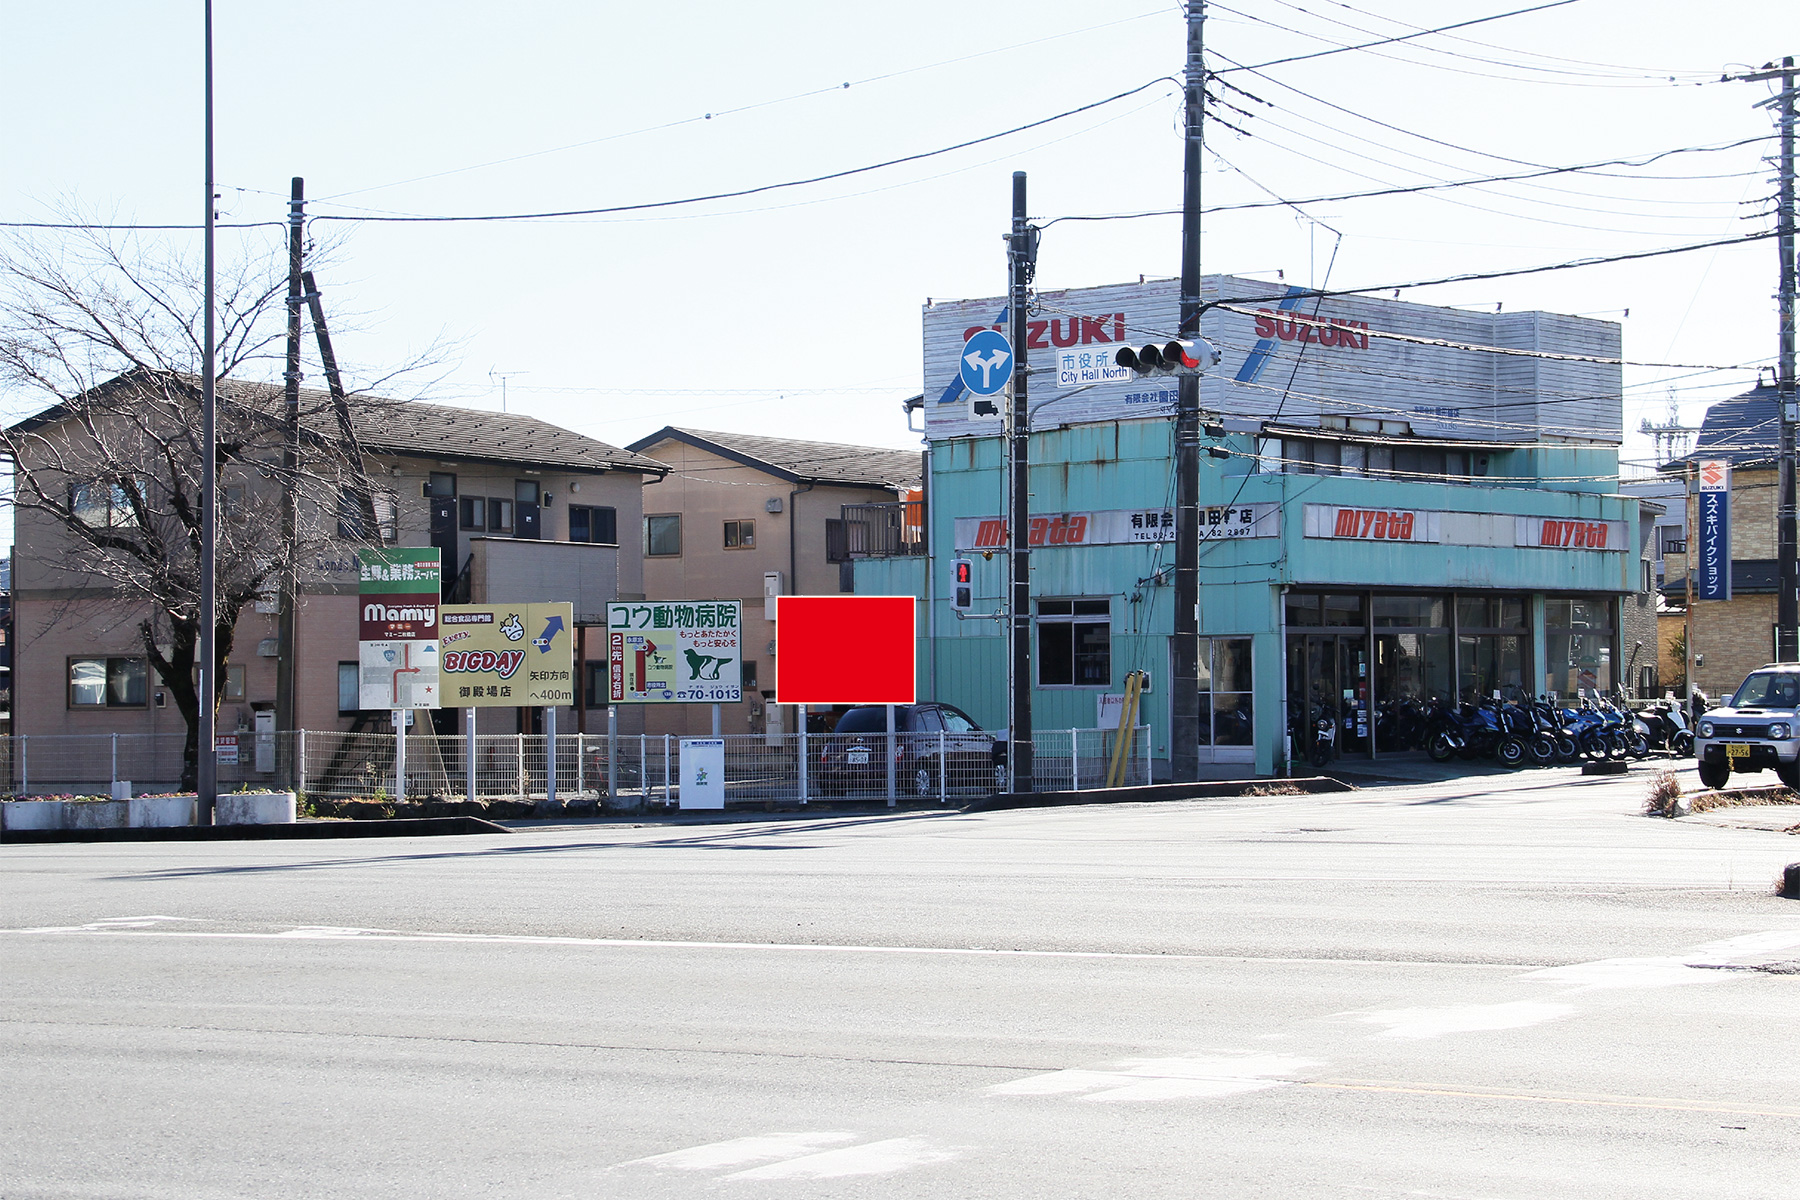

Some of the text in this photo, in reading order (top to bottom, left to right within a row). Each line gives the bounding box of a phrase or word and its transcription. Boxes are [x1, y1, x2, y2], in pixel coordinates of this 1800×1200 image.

[1255, 308, 1369, 350] SUZUKI
[1062, 351, 1118, 370] 市役所
[1061, 367, 1128, 383] City Hall North
[975, 517, 1087, 547] miata
[1135, 532, 1151, 540] TEL
[1706, 494, 1718, 595] スズキバイクショップ
[611, 604, 737, 628] ユウ動物病院
[442, 631, 470, 646] Every
[680, 630, 736, 638] もっとあたたかく
[530, 671, 569, 680] 矢印方向
[459, 686, 511, 697] 御殿場店
[530, 690, 572, 699] へ400m
[688, 690, 740, 700] 70-1013
